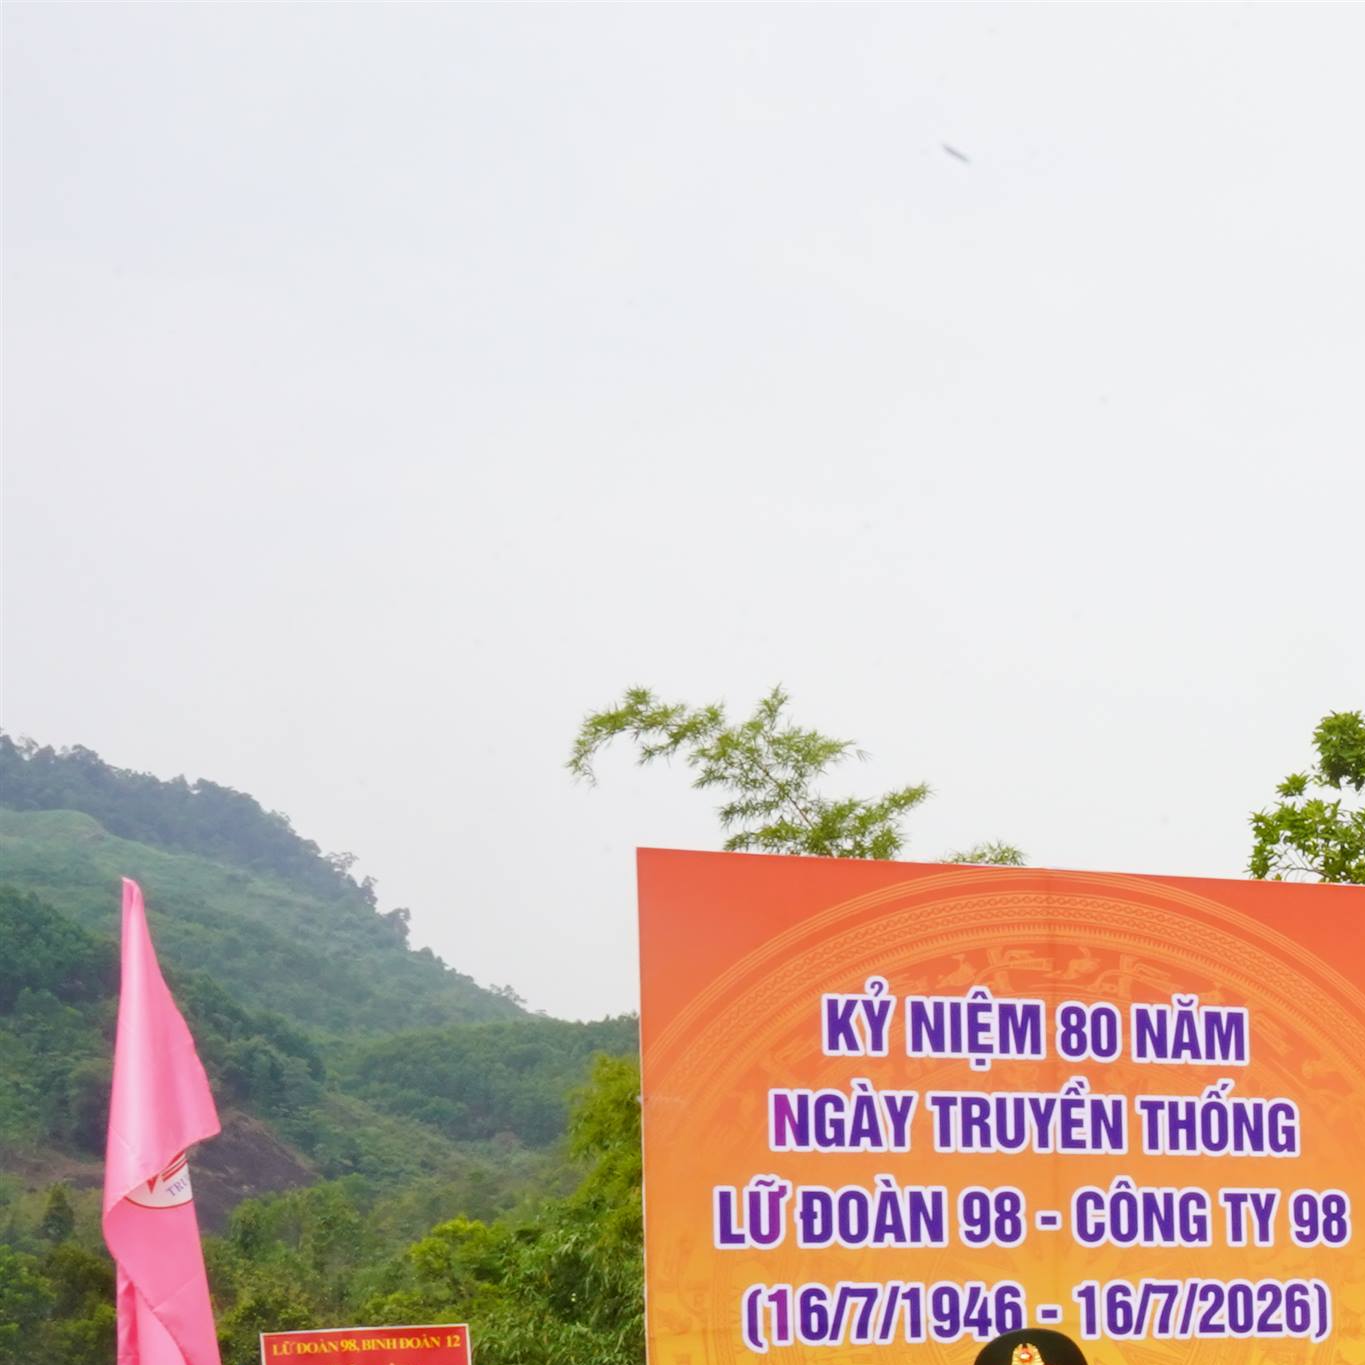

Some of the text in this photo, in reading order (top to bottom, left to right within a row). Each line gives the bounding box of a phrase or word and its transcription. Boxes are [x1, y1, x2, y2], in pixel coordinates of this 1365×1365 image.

[825, 980, 1247, 1067] KỶ NIỆM 80 NĂM
[773, 1080, 1296, 1153] NGÀY TRUYỀN THỐNG
[718, 1178, 787, 1245] LỮ
[799, 1178, 945, 1244] ĐOÀN
[963, 1190, 1024, 1244] 98
[1075, 1179, 1208, 1244] CÔNG
[1223, 1192, 1277, 1243] TY
[1294, 1192, 1349, 1244] 98
[745, 1285, 1024, 1350] (16/7/1946
[1077, 1283, 1331, 1338] 16/7/2026)
